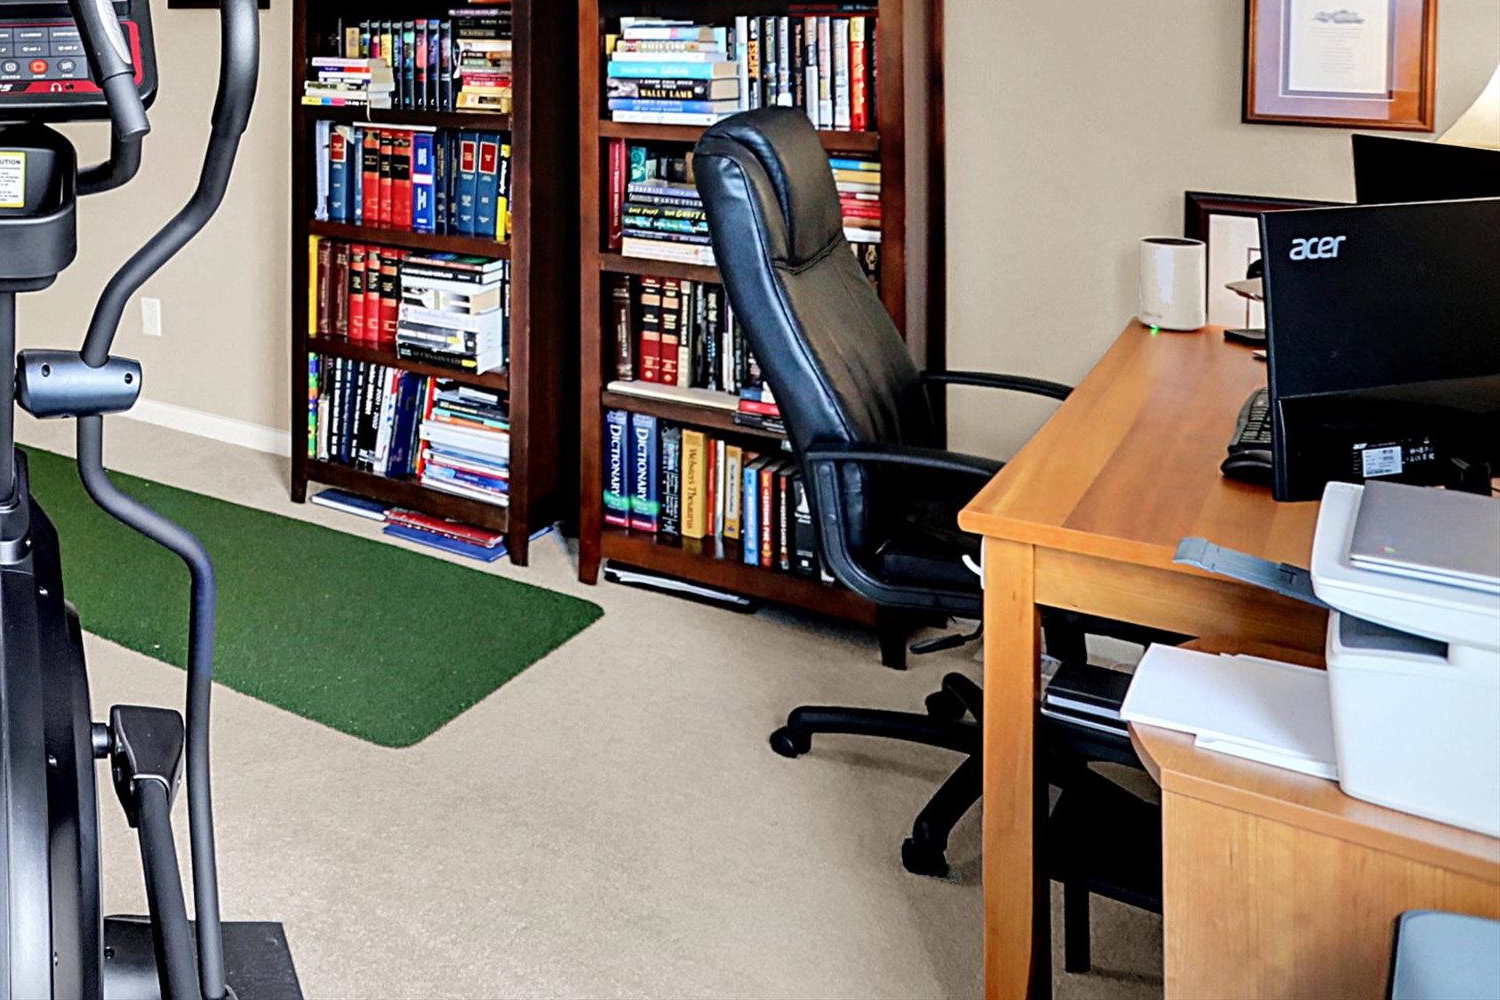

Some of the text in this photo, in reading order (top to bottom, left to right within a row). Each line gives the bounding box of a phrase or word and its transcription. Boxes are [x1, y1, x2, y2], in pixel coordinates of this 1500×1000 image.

[748, 40, 759, 79] ESCAPE
[640, 89, 693, 99] WALLY LAMB
[1289, 235, 1347, 260] acer
[610, 424, 622, 498] DICTIONARY
[636, 428, 649, 502] DICTIONARY
[687, 486, 697, 529] Thesaurus
[762, 526, 770, 541] FIRE
